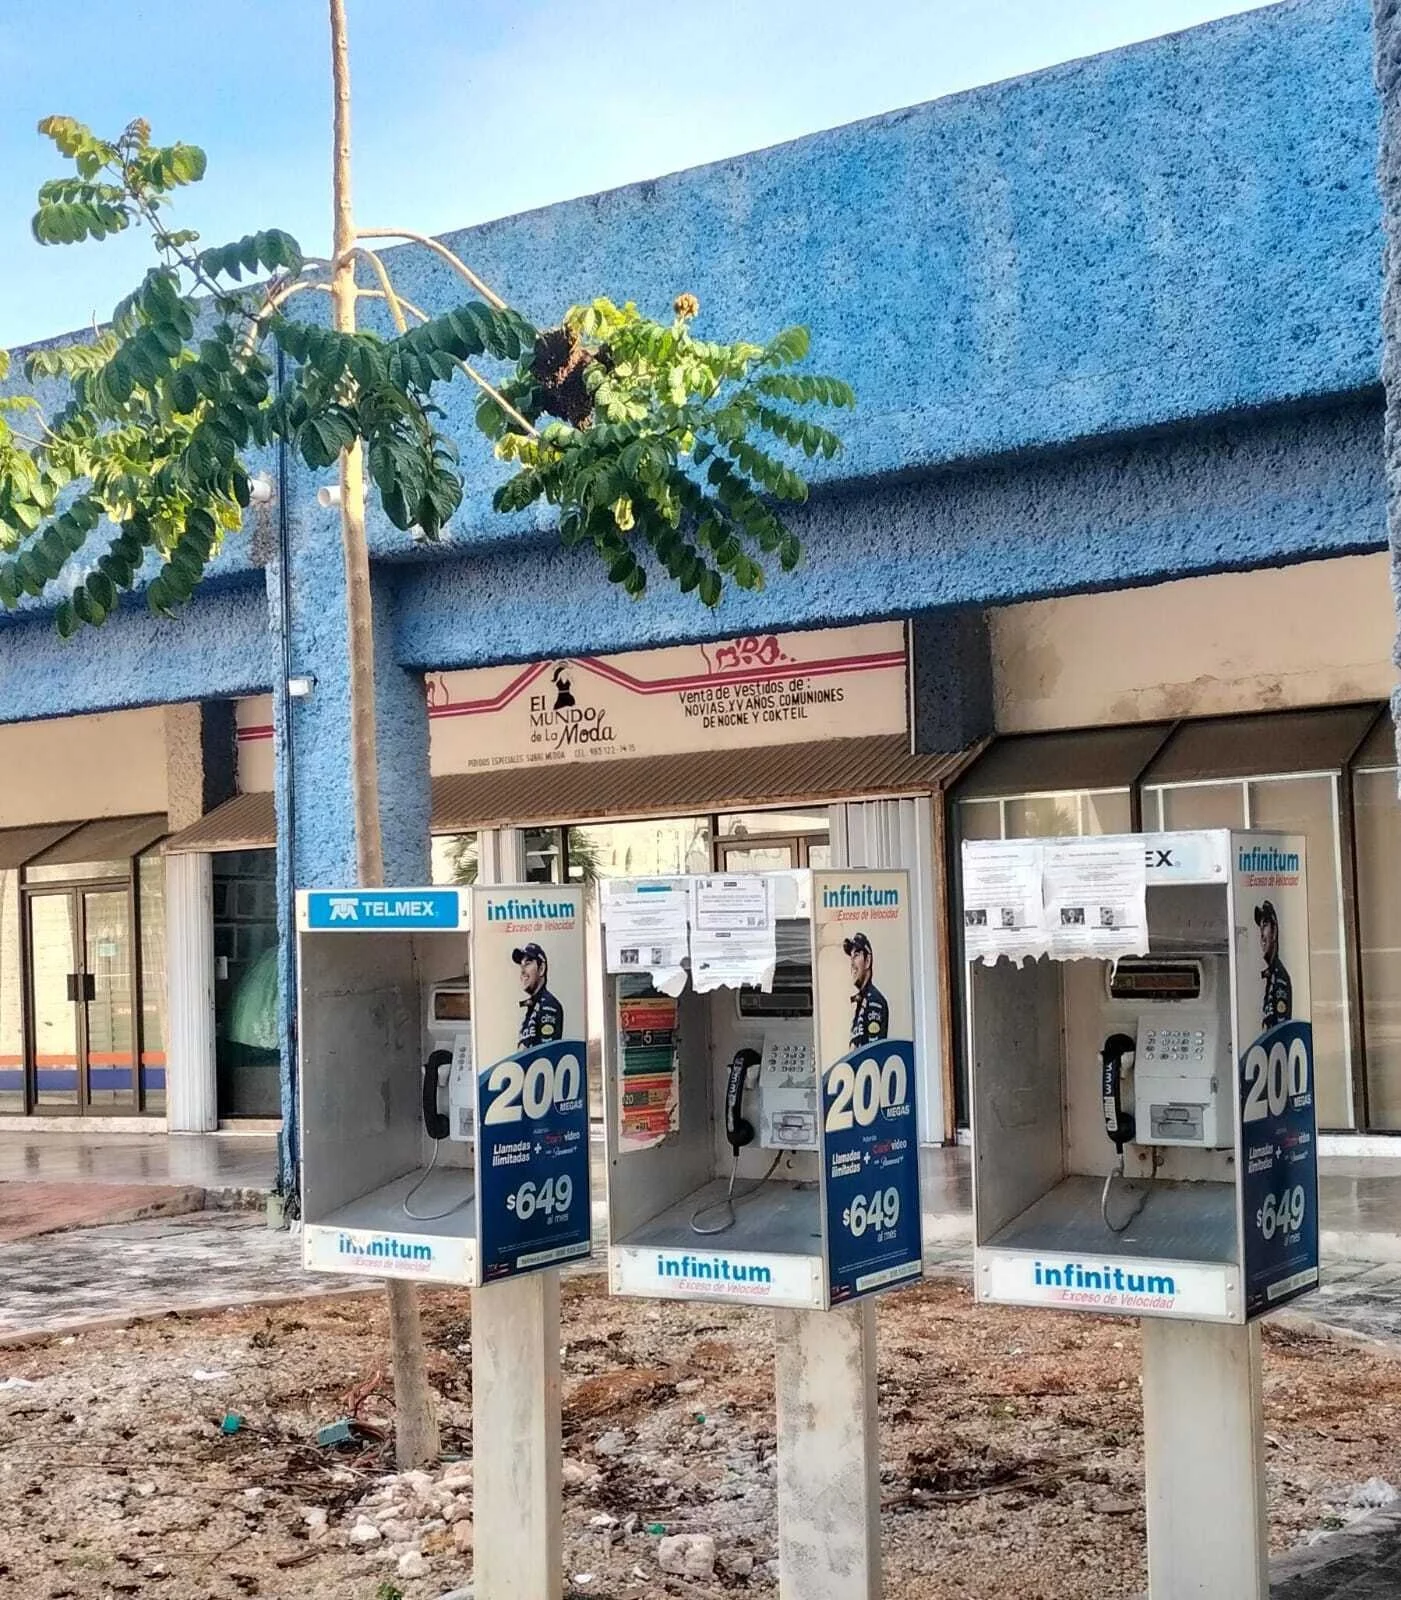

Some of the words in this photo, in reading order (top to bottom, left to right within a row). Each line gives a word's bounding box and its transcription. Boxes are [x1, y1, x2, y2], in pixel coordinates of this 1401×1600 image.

[530, 695, 546, 712] El
[715, 685, 730, 700] de
[780, 688, 844, 706] COMUNIONES
[530, 707, 597, 727] MUNDO
[703, 716, 715, 728] DE
[752, 711, 759, 723] Y
[763, 706, 808, 722] COKTEIL
[531, 731, 542, 743] de
[555, 709, 617, 749] Moda
[1239, 846, 1299, 872] infinitum
[823, 884, 899, 908] infinitum
[362, 901, 434, 917] TELMEX
[487, 898, 575, 920] infinitum
[837, 910, 860, 921] Exceso
[860, 909, 869, 920] de
[484, 1054, 580, 1125] 200
[1243, 1037, 1308, 1123] 200
[825, 1054, 907, 1133] 200
[560, 1100, 583, 1112] MEGAS
[886, 1105, 910, 1118] MEGAS
[493, 1140, 531, 1155] Llamadas
[505, 1174, 573, 1220] $649
[842, 1186, 900, 1237] $649
[1257, 1185, 1305, 1240] $649
[658, 1255, 771, 1283] infinitum
[1035, 1262, 1175, 1294] infinitum
[679, 1279, 712, 1290] Exceso
[714, 1281, 725, 1291] de
[726, 1282, 770, 1295] Velocidad
[1061, 1289, 1102, 1303] Exceso
[1103, 1291, 1118, 1304] de
[1120, 1293, 1176, 1309] Velocidad
